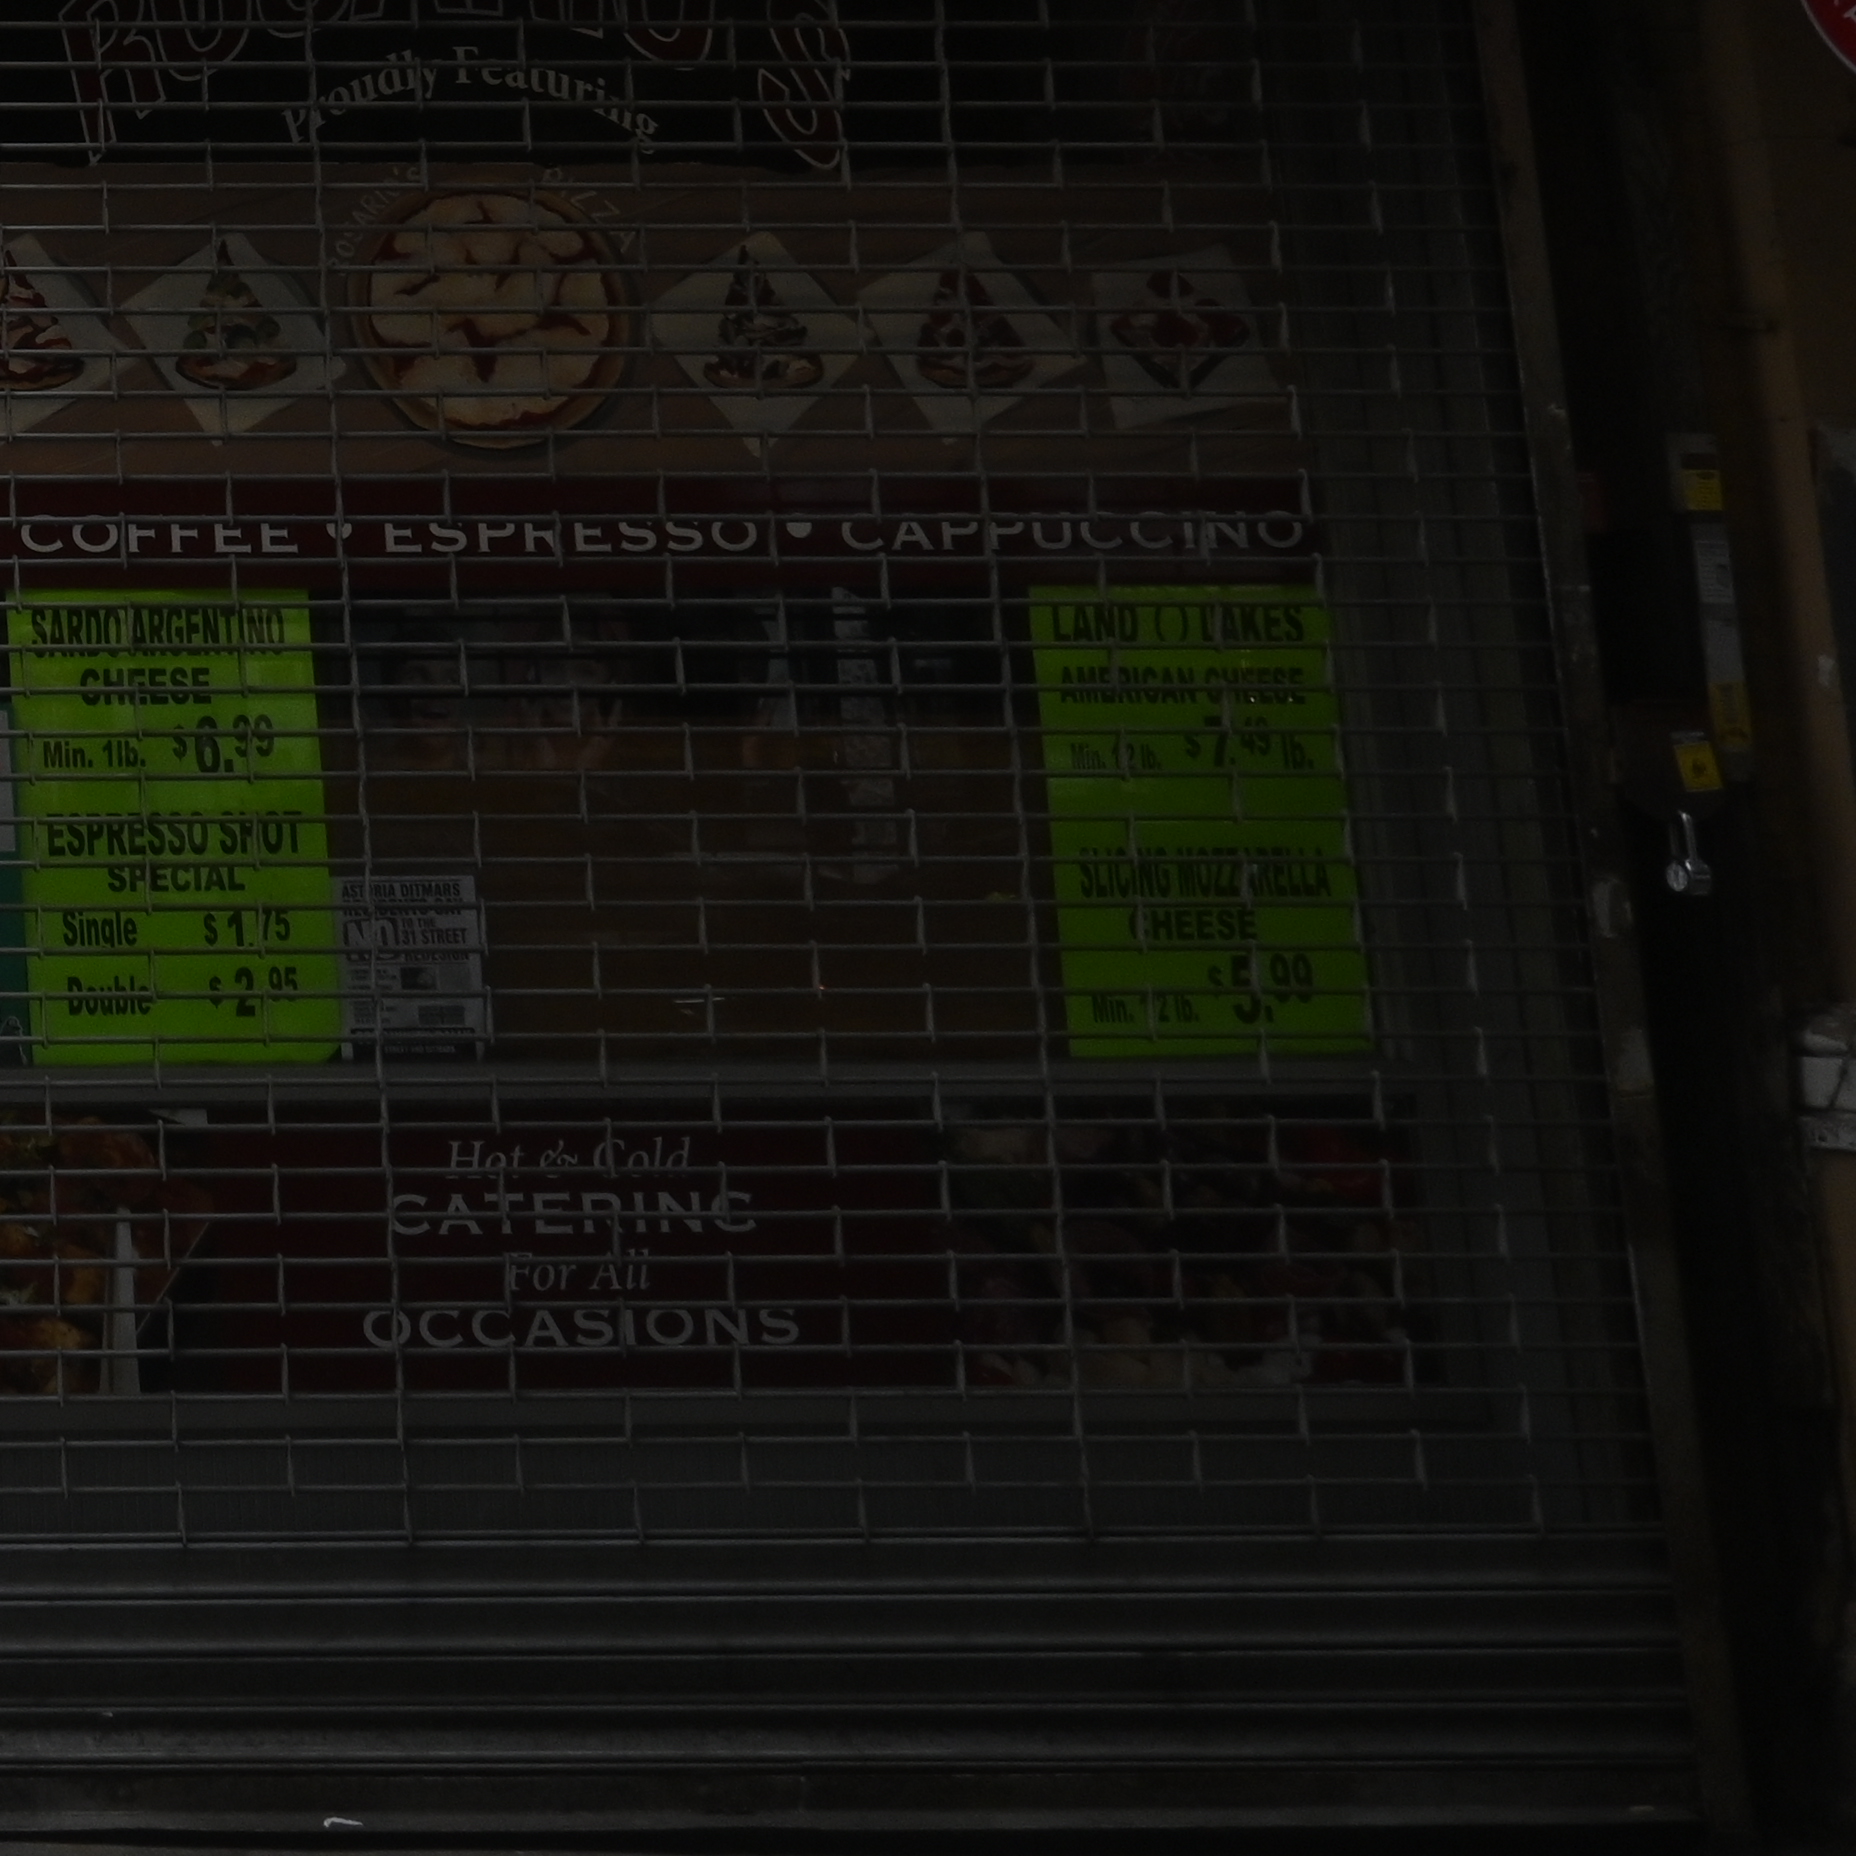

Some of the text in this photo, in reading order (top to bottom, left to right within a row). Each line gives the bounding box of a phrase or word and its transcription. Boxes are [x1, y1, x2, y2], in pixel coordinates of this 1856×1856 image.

[281, 45, 659, 155] Proudly Featuring
[19, 514, 301, 555] COFFEE
[383, 513, 759, 554] ESPRESSO
[840, 509, 1305, 551] CAPPUCCINO
[31, 607, 286, 658] SARDO ARGENTINO
[1051, 604, 1139, 642] LAND
[1200, 605, 1305, 642] LAKES
[80, 667, 213, 706] CHEESE
[1060, 666, 1306, 705] AMERICAN CHEESE
[43, 740, 94, 769] Min.
[102, 739, 146, 769] 1lb.
[46, 811, 208, 856] ESPRESSO
[107, 864, 246, 893] SPECIAL
[342, 882, 461, 898] ASTRIA DITMARS
[1078, 846, 1332, 898] SLICING MOZZARELLA
[62, 911, 138, 948] Single
[401, 928, 467, 945] 31 STREET
[1128, 908, 1258, 941] CHEESE
[67, 975, 152, 1016] Double
[208, 966, 298, 1017] $295
[448, 1137, 528, 1183] Hot
[592, 1135, 692, 1175] Cold
[389, 1191, 756, 1236] CATERING
[504, 1248, 652, 1293] For All
[362, 1305, 801, 1350] OCCASIONS
